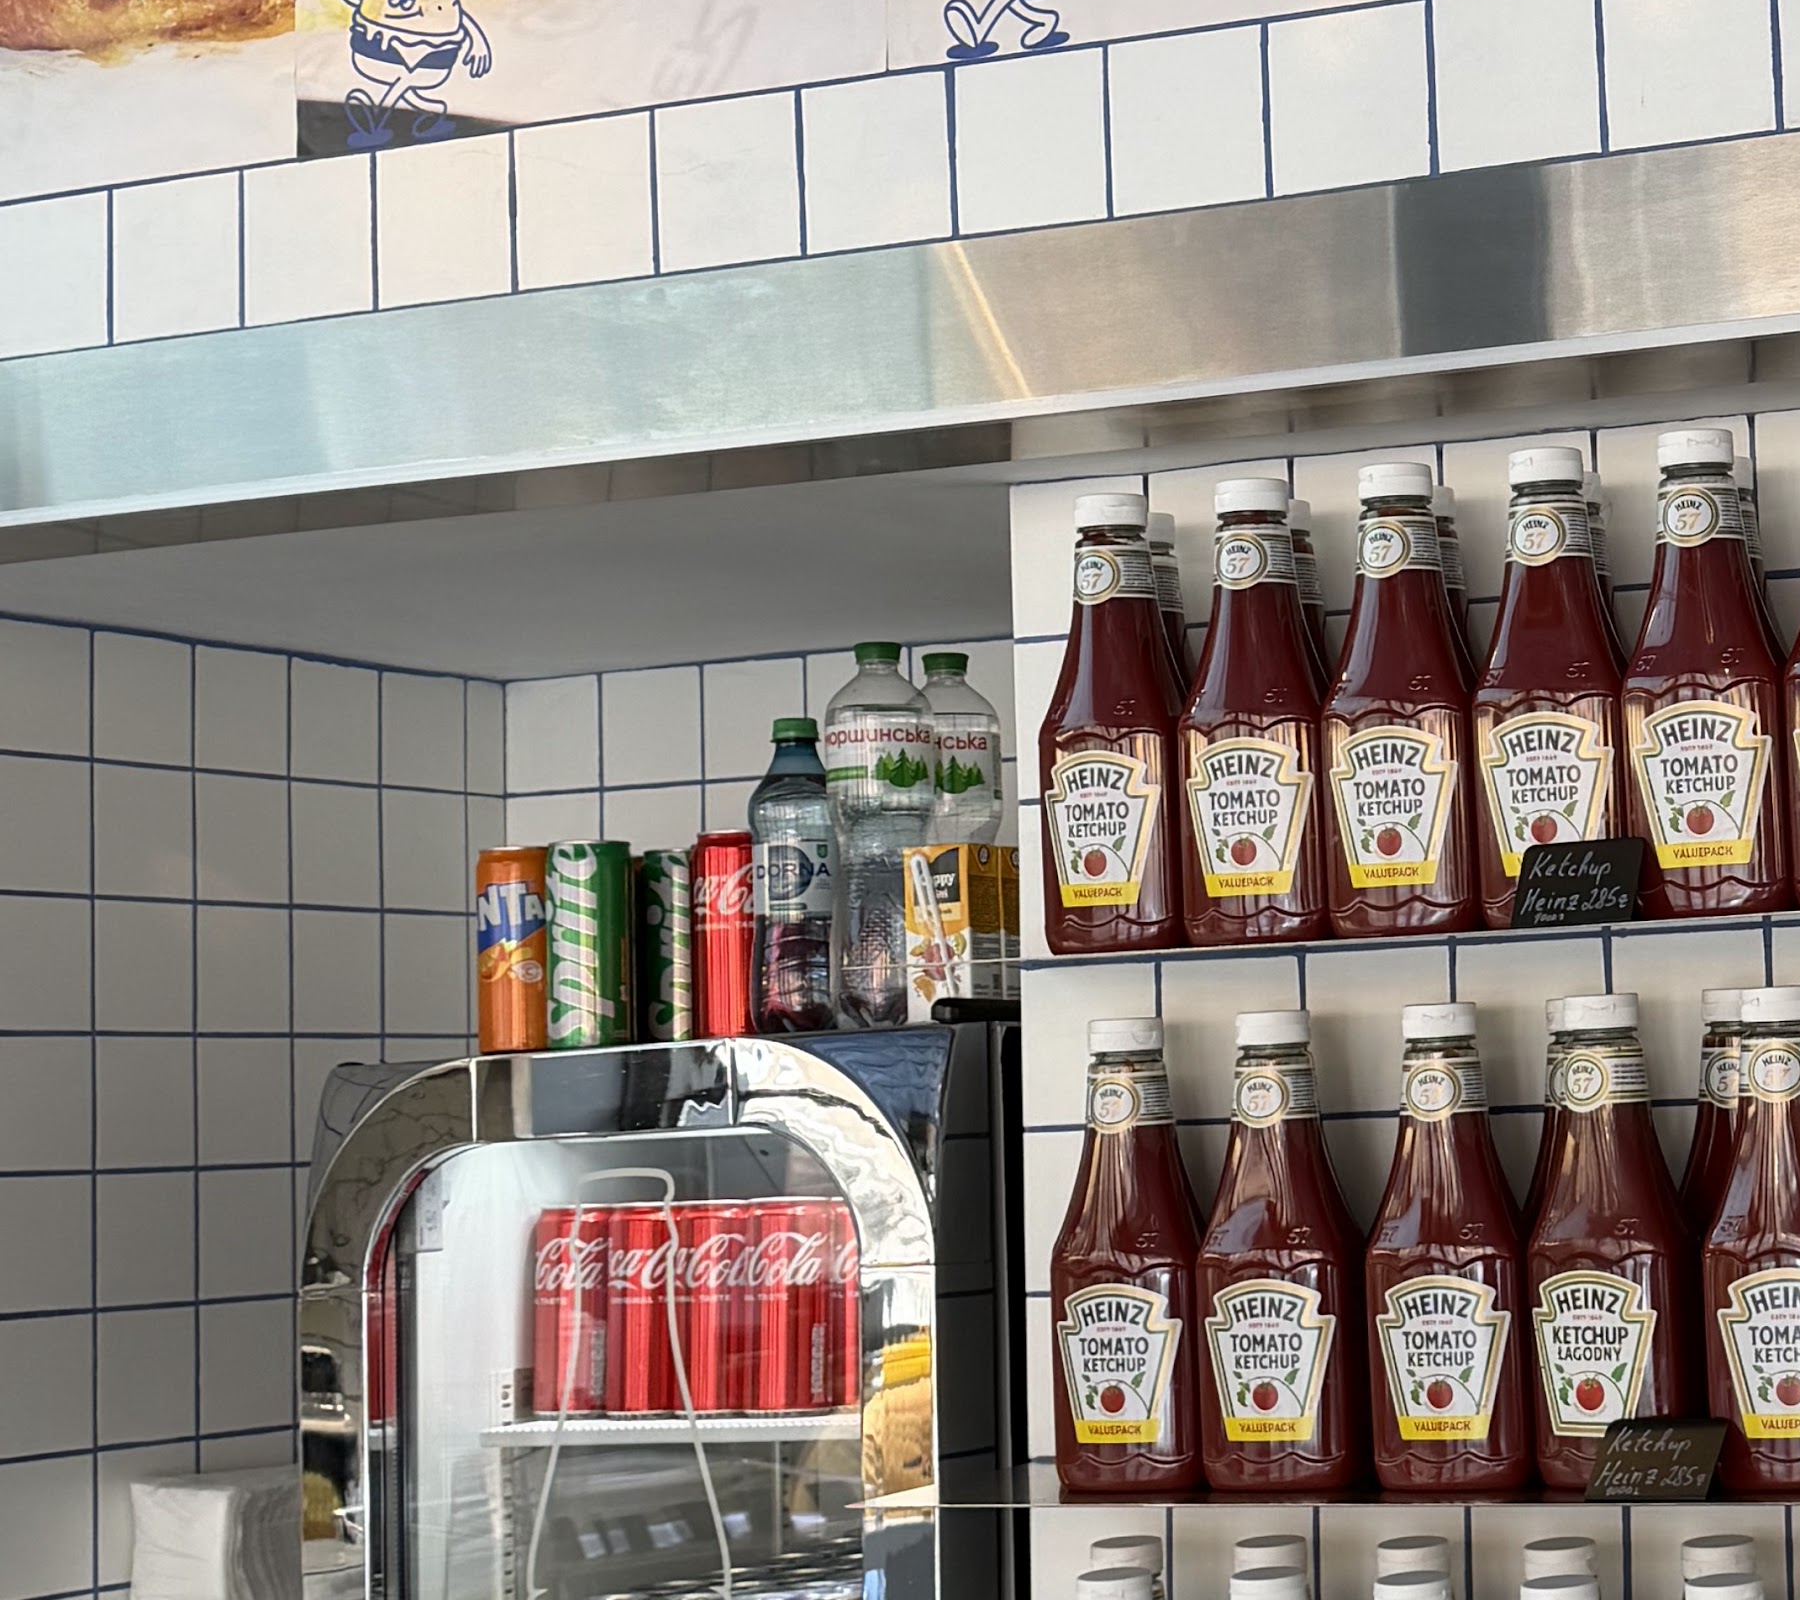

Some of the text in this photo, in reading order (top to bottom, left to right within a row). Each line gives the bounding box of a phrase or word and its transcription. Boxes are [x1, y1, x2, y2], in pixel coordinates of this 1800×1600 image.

[825, 725, 932, 748] оршинська
[1508, 729, 1576, 758] HEINZ
[1661, 718, 1732, 747] HEINZ
[1210, 754, 1275, 781] HEINZ
[1354, 743, 1420, 770] HEINZ
[1660, 754, 1738, 778] TOMATO
[1506, 764, 1581, 787] TOMATO
[1666, 775, 1736, 794] KETCHUP
[1208, 789, 1280, 811] TOMATO
[1353, 778, 1425, 800] TOMATO
[1512, 785, 1578, 804] KETCHUP
[1213, 809, 1278, 827] KETCHUP
[1358, 798, 1423, 817] KETCHUP
[1529, 851, 1612, 884] Ketchup
[478, 882, 545, 932] NTA
[1520, 888, 1580, 915] Heinz
[1232, 1296, 1298, 1323] HEINZ
[1404, 1293, 1472, 1320] HEINZ
[1556, 1288, 1621, 1314] HEINZ
[1080, 1301, 1144, 1327] HEINZ
[1078, 1336, 1149, 1356] TOMATO
[1230, 1332, 1302, 1353] TOMATO
[1402, 1330, 1477, 1350] TOMATO
[1552, 1326, 1629, 1345] KETCHUP
[1083, 1357, 1146, 1373] KETCHUP
[1234, 1354, 1300, 1370] KETCHUP
[1408, 1351, 1474, 1367] KETCHUP
[1557, 1346, 1622, 1362] ŁAGODNY
[1607, 1426, 1692, 1461] Ketchup
[1594, 1460, 1659, 1487] Heinz
